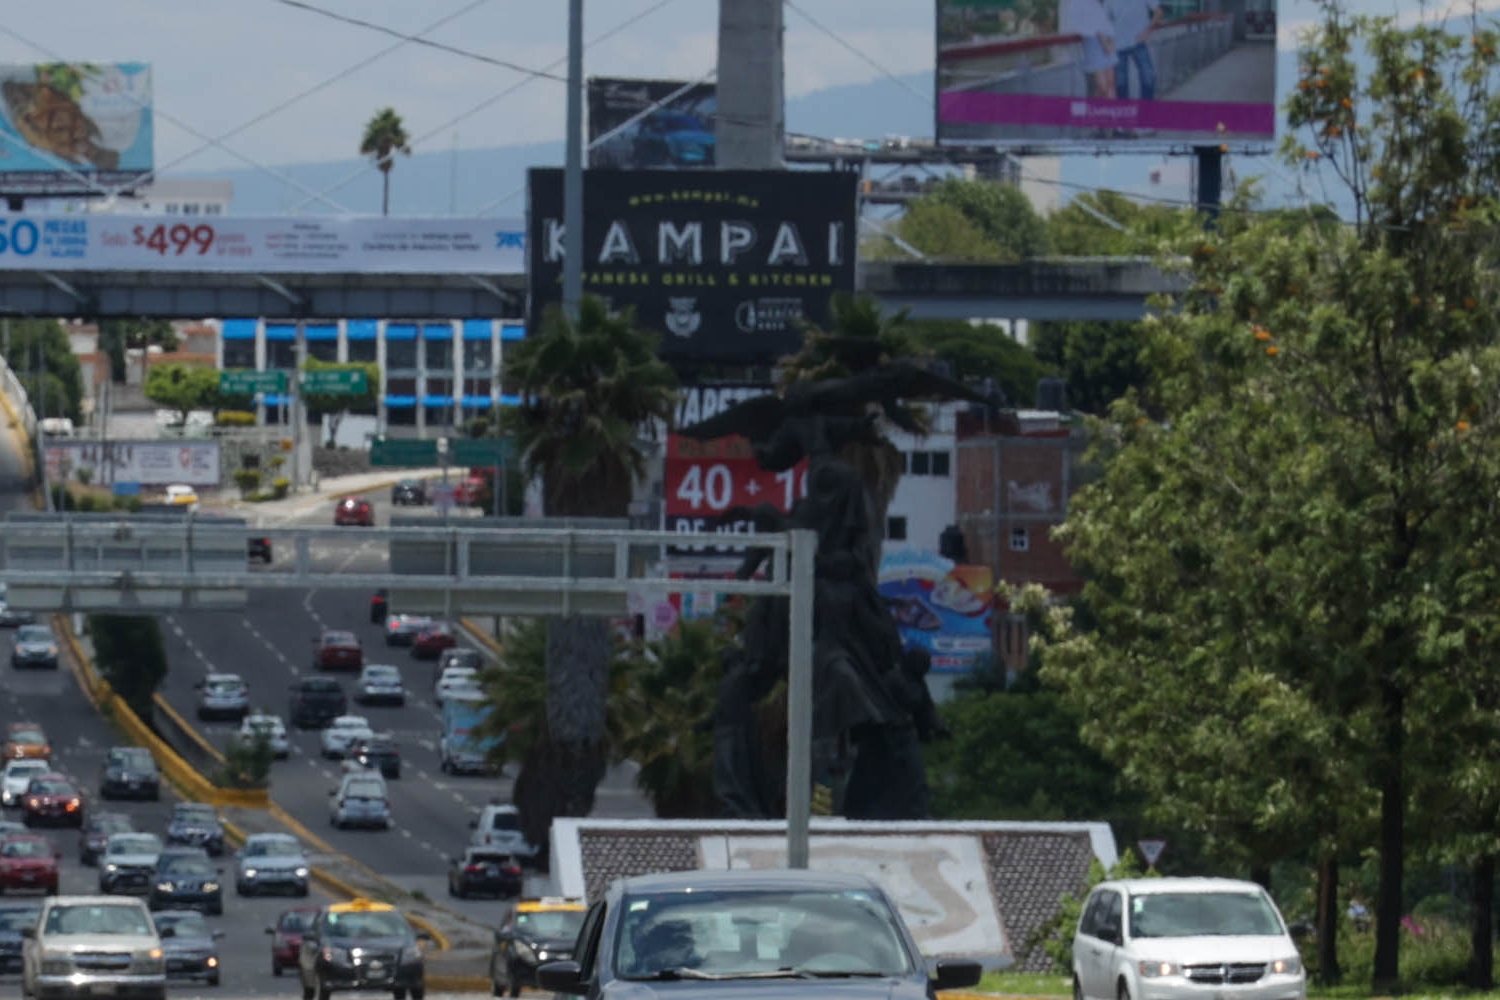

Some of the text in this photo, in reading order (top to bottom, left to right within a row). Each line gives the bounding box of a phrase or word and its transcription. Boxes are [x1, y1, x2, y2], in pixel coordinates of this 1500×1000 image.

[133, 223, 214, 256] $499
[543, 217, 844, 265] KAMPAI
[662, 272, 716, 286] GRILL
[677, 464, 732, 510] 40
